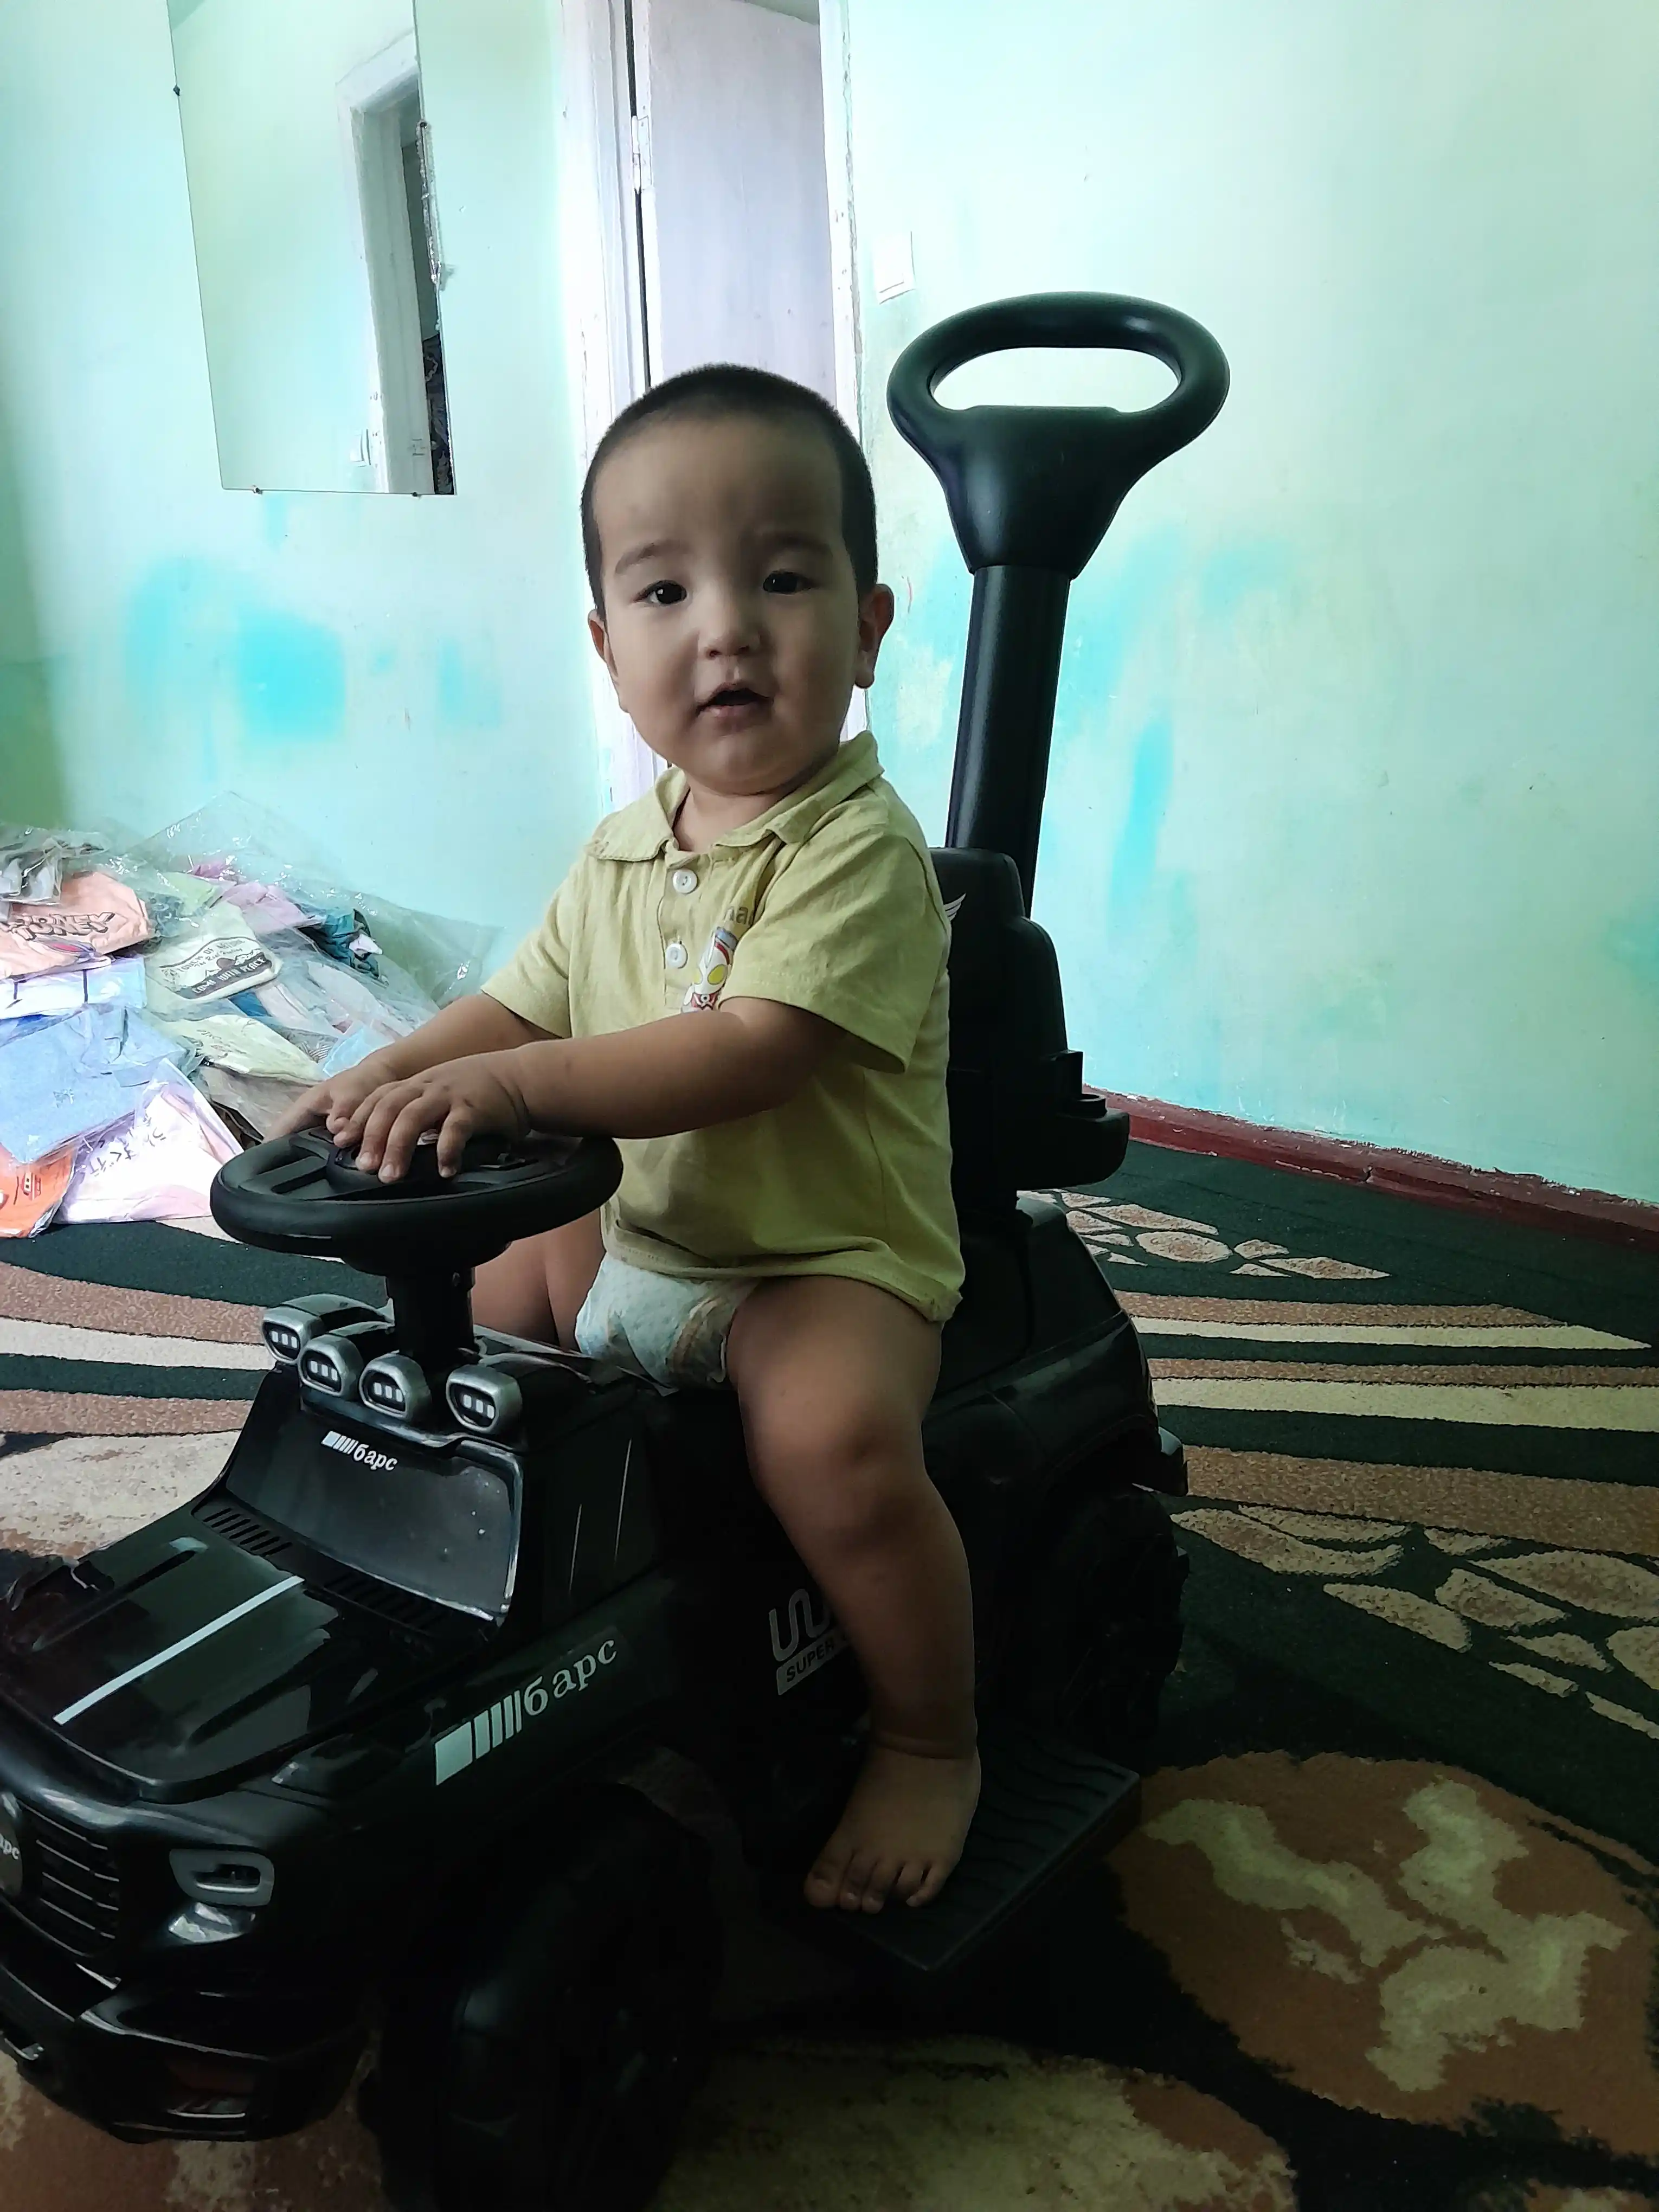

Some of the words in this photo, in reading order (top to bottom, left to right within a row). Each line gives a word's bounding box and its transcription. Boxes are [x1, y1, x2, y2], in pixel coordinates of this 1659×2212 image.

[353, 1443, 398, 1471] барс
[523, 1639, 617, 1716] барс
[786, 1638, 834, 1682] SUPER
